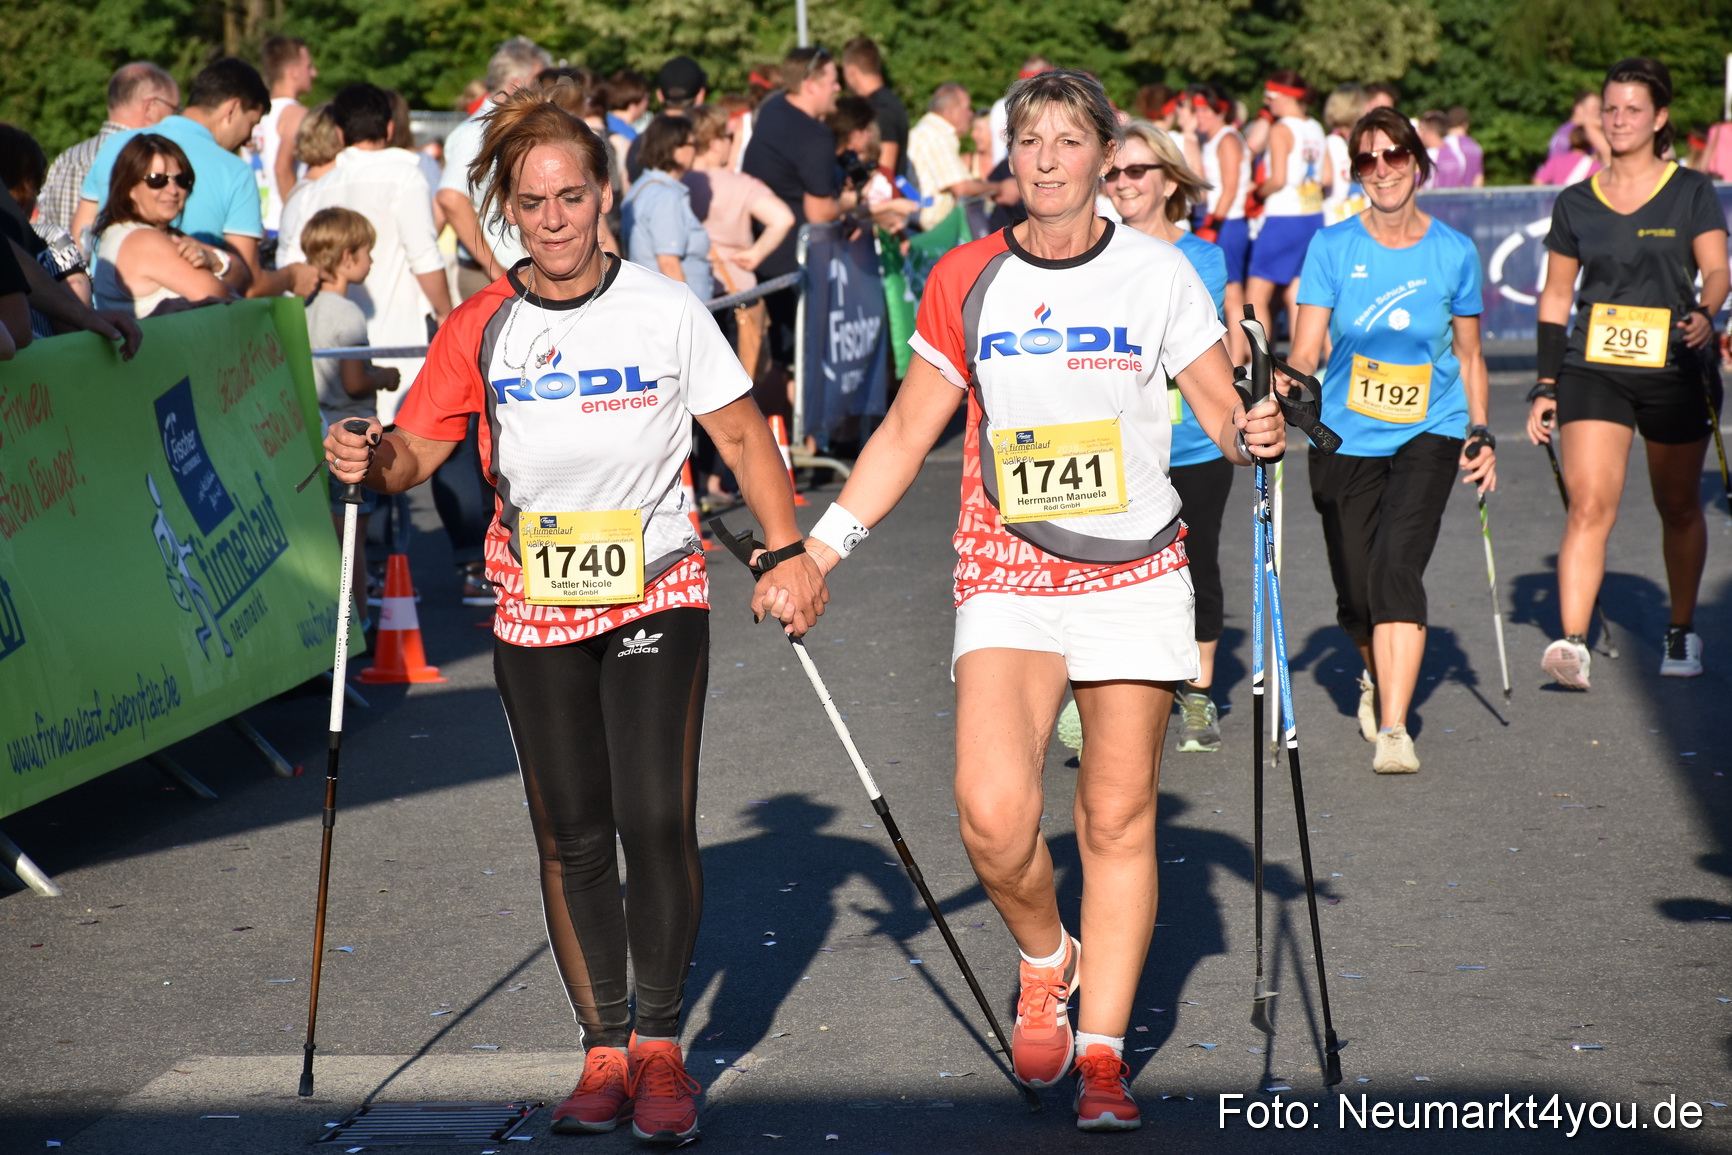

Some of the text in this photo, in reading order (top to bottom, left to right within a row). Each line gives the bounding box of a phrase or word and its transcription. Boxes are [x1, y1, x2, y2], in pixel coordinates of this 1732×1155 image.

[1354, 278, 1428, 327] Team Schick Bau
[1604, 326, 1648, 348] 296
[1067, 351, 1143, 373] energie
[581, 386, 659, 414] energie
[1360, 379, 1419, 406] 1192
[1010, 440, 1051, 452] firmenlauf
[1001, 456, 1035, 465] walken
[1012, 454, 1102, 495] 1741
[1017, 490, 1107, 506] Herrmann Manuela
[1060, 502, 1081, 510] GmbH
[190, 471, 289, 611] firmenlauf
[533, 526, 574, 535] firmenlauf
[526, 539, 557, 548] walken
[535, 544, 626, 579] 1740
[551, 579, 612, 589] Sattler Nicole
[229, 588, 269, 643] neumarkt
[617, 646, 659, 658] adidas
[6, 662, 181, 776] www.firmenlauf-oberpfalz.de
